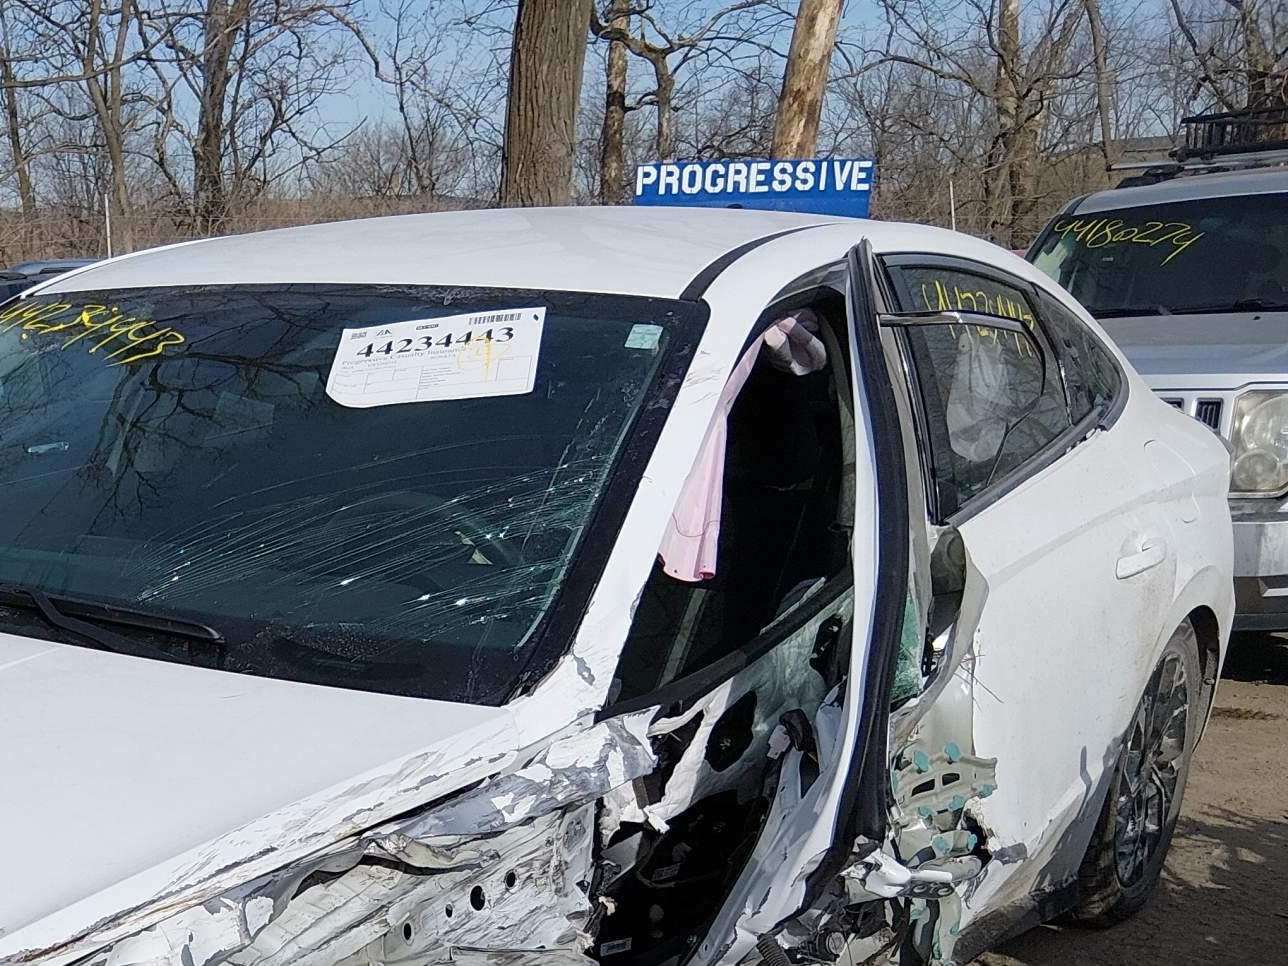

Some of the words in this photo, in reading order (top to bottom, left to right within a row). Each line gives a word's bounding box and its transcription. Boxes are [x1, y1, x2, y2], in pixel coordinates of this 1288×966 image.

[635, 160, 873, 196] PROGRESSIVE
[1054, 218, 1205, 267] 44180274
[356, 326, 515, 358] 44234443
